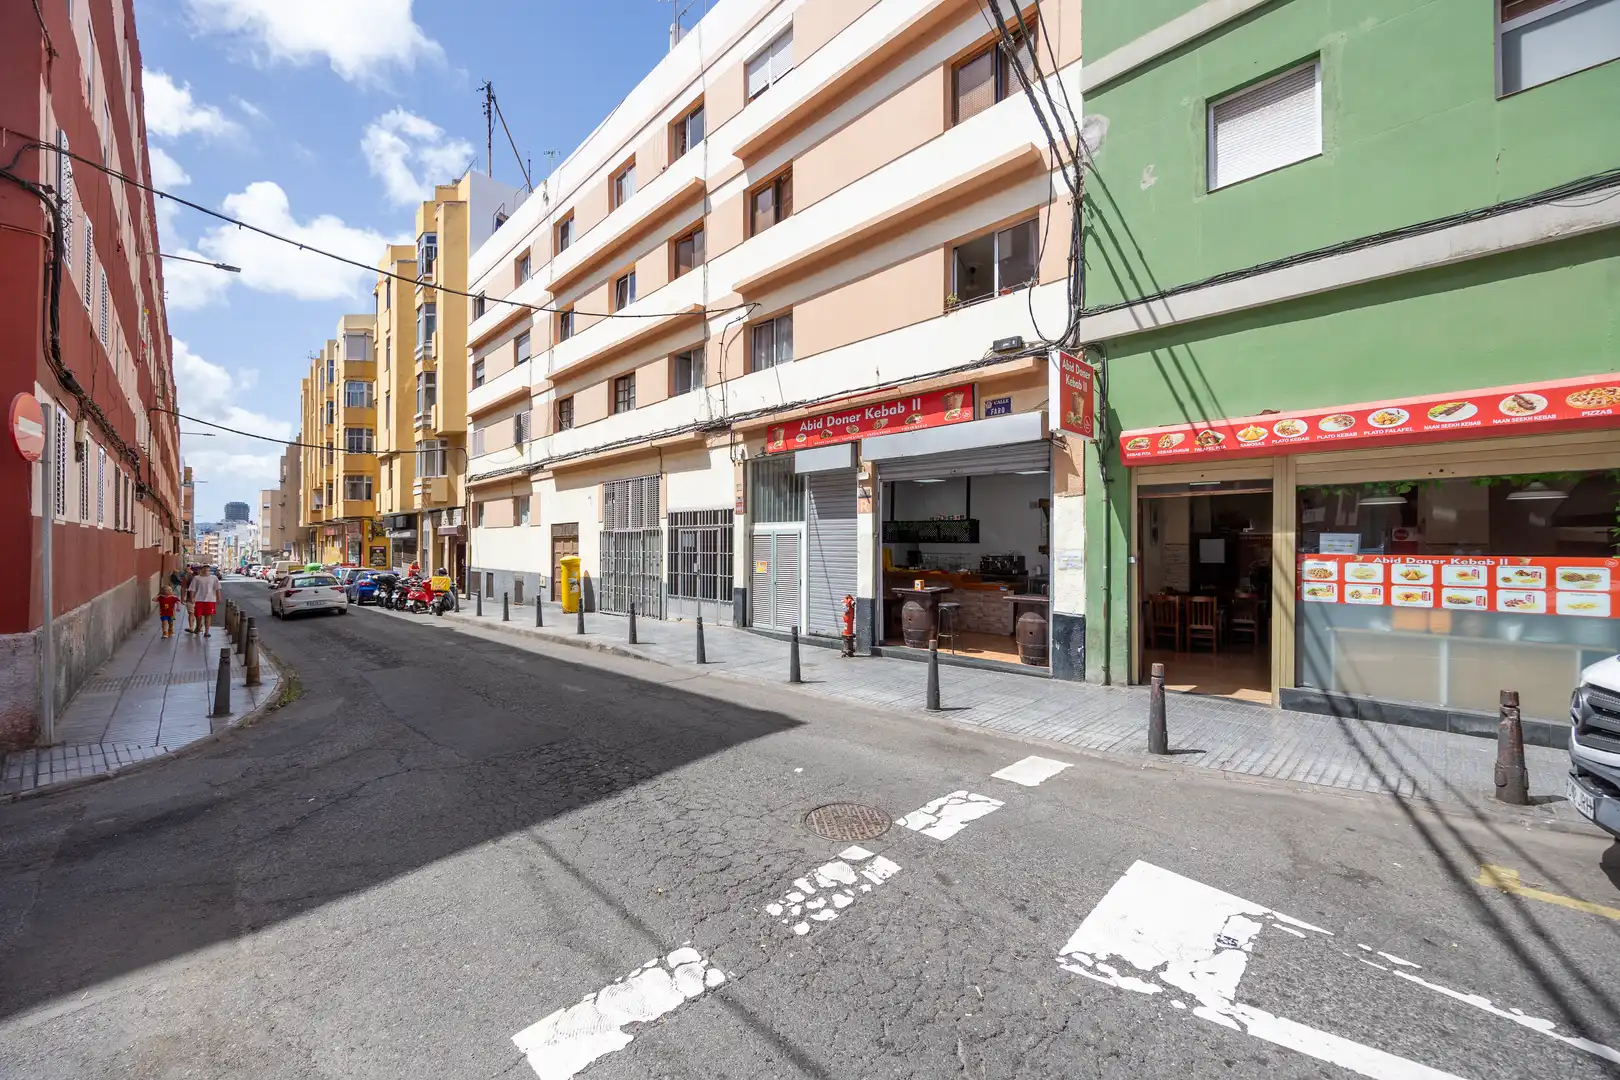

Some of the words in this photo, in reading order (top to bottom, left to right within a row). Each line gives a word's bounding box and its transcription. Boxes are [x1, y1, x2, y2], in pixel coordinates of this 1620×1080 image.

[1062, 359, 1075, 373] Abid
[1075, 363, 1091, 380] Doner
[1065, 374, 1082, 390] Kebab
[990, 406, 1006, 416] FARO
[1581, 409, 1613, 417] PIZZAS
[800, 415, 823, 432] Abid
[826, 412, 861, 428] Doner
[865, 403, 905, 420] Kebab
[1534, 413, 1557, 421] KEBAB
[1336, 431, 1358, 439] KEBAB
[1406, 557, 1446, 565] Doner
[1450, 558, 1495, 566] Kebab
